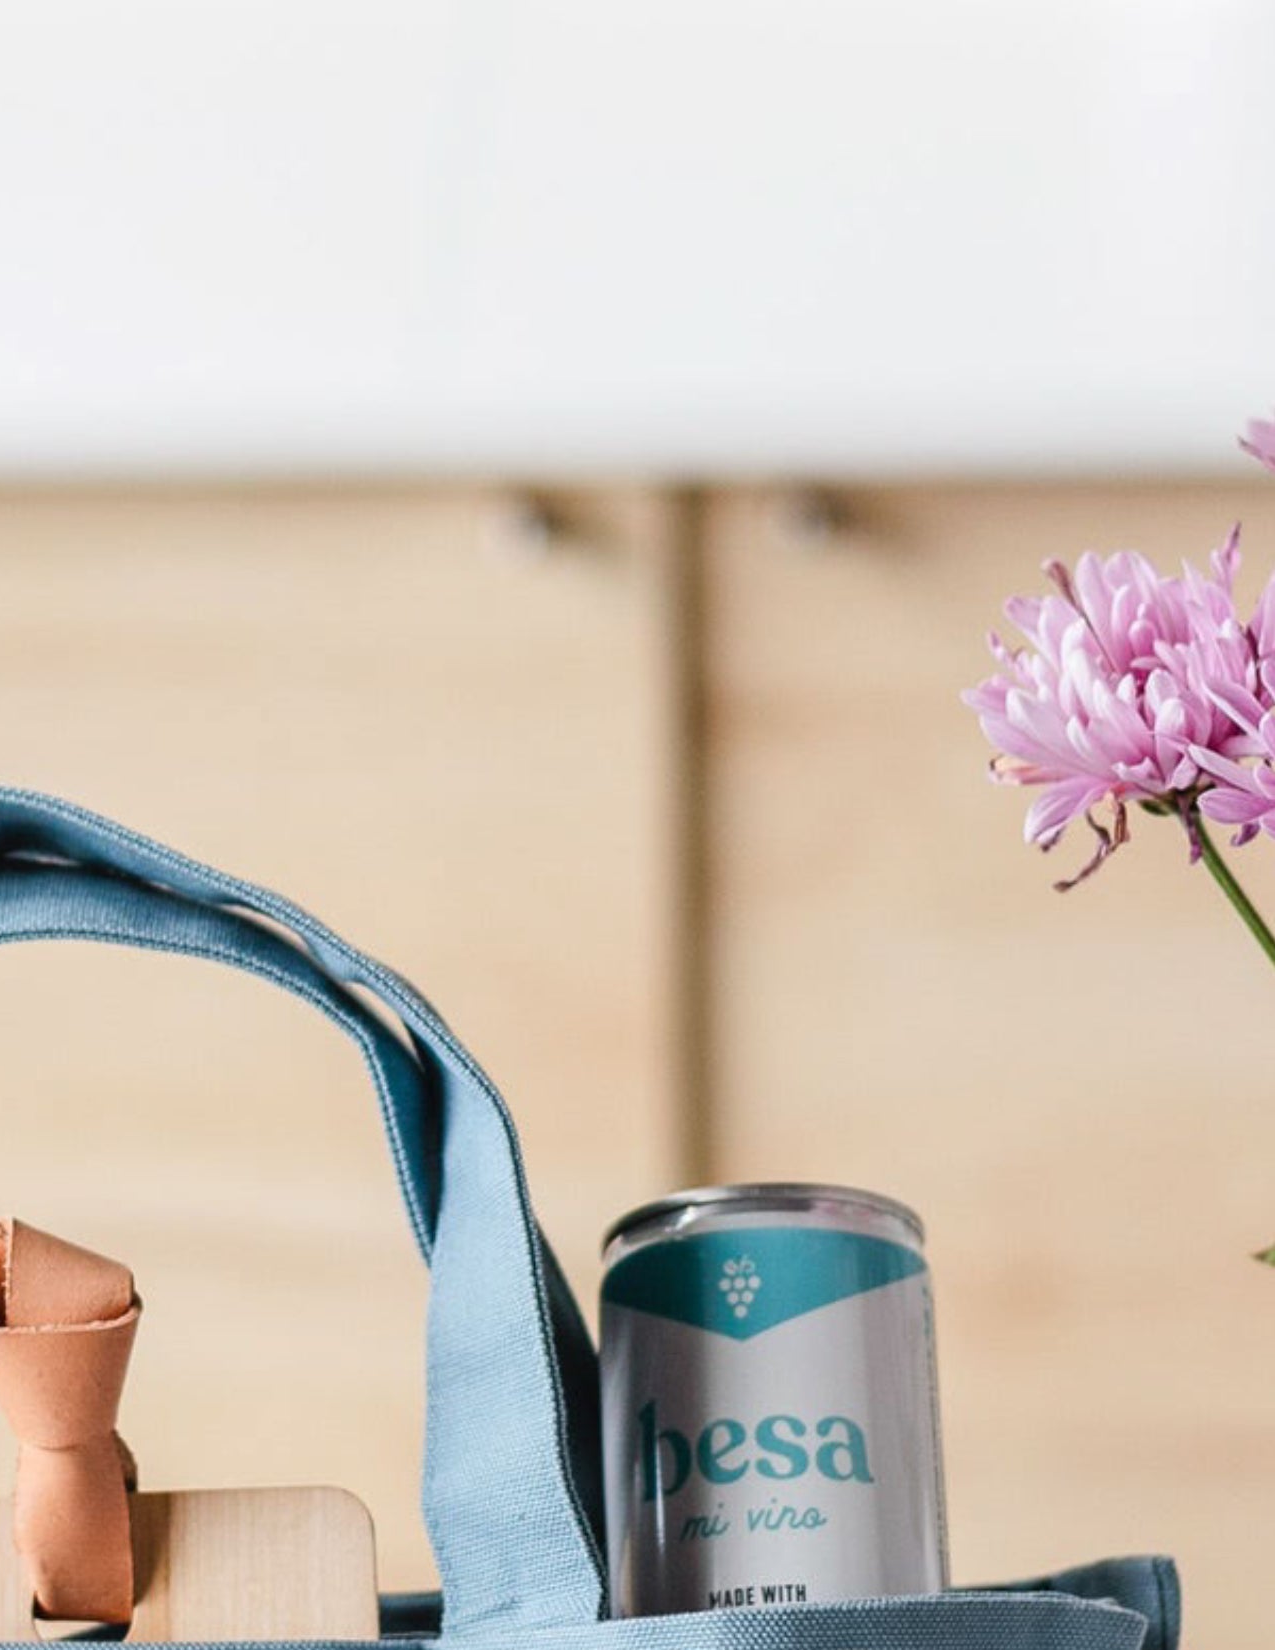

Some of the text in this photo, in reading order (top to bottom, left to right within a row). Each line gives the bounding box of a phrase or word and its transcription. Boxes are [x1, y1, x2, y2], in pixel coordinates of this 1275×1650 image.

[637, 1401, 875, 1503] besa
[679, 1497, 828, 1542] mi vino
[708, 1583, 807, 1609] MADE WITH
